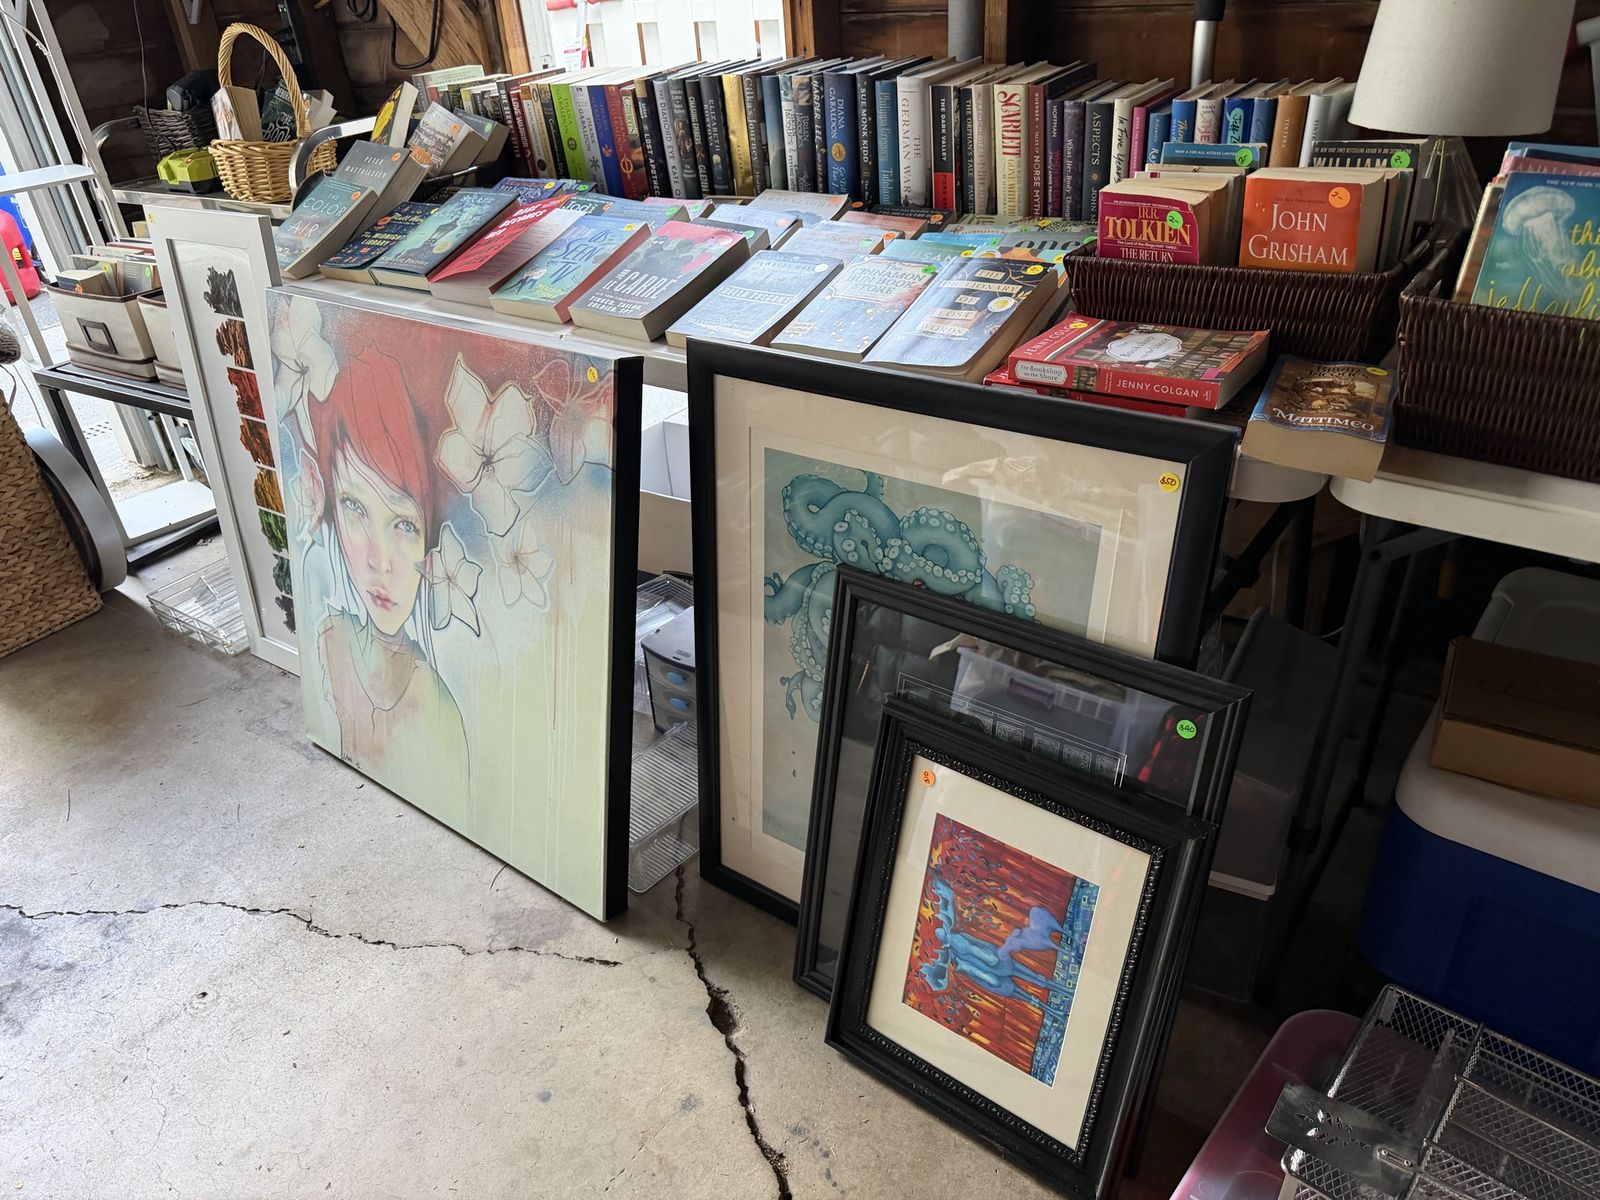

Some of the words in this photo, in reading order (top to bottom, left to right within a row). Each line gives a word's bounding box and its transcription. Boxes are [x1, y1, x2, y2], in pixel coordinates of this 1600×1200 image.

[511, 98, 521, 115] LOVE
[688, 96, 699, 122] CHASING
[811, 80, 822, 119] HARPER
[556, 88, 569, 133] GABALDON
[563, 98, 574, 125] DIANA
[829, 87, 838, 139] GABALDON
[837, 99, 845, 129] DIANA
[578, 108, 592, 152] GABALDON
[587, 117, 596, 143] DIANA
[659, 102, 672, 141] DIAMOND
[708, 100, 721, 151] ELIZABETH
[901, 98, 911, 160] GERMAN
[997, 91, 1021, 158] SCARLETT
[1229, 114, 1242, 134] Jeff
[644, 133, 654, 155] LOST
[748, 119, 758, 162] Journey
[814, 124, 823, 145] LEE
[966, 117, 974, 156] ORPHAN'S
[1091, 112, 1102, 166] ASPECTS
[1117, 127, 1129, 148] Five
[1281, 119, 1290, 149] TINTERA
[666, 145, 676, 160] EYE
[913, 134, 921, 159] THE
[670, 165, 680, 185] KATE
[1065, 160, 1073, 173] Her
[1113, 153, 1125, 184] Years
[648, 159, 661, 198] APOTHEC
[903, 166, 912, 194] WAR
[1065, 176, 1073, 194] Body
[302, 198, 348, 217] COLOR
[562, 200, 598, 214] Jodi
[1138, 206, 1160, 219] J.R.R.
[288, 220, 319, 237] AIR
[1271, 204, 1328, 233] JOHN
[1104, 215, 1192, 246] TOLKIEN
[1120, 247, 1138, 259] THE
[1139, 249, 1175, 262] RETURN
[1248, 234, 1348, 265] GRISHAM
[613, 271, 683, 299] CARRÉ
[846, 274, 875, 285] BUN
[875, 277, 919, 289] BOOK
[851, 268, 926, 281] CINNAMON
[979, 270, 1002, 279] THE
[853, 283, 896, 295] STORE
[941, 281, 1021, 293] DICTIONARY
[958, 296, 976, 304] OF
[937, 311, 972, 319] LOST
[922, 323, 964, 335] WORDS
[1024, 339, 1051, 356] JENNY
[1029, 365, 1063, 376] Bookshop
[1039, 373, 1059, 381] Shore
[1116, 379, 1151, 391] JENNY
[1153, 384, 1199, 398] COLGAN
